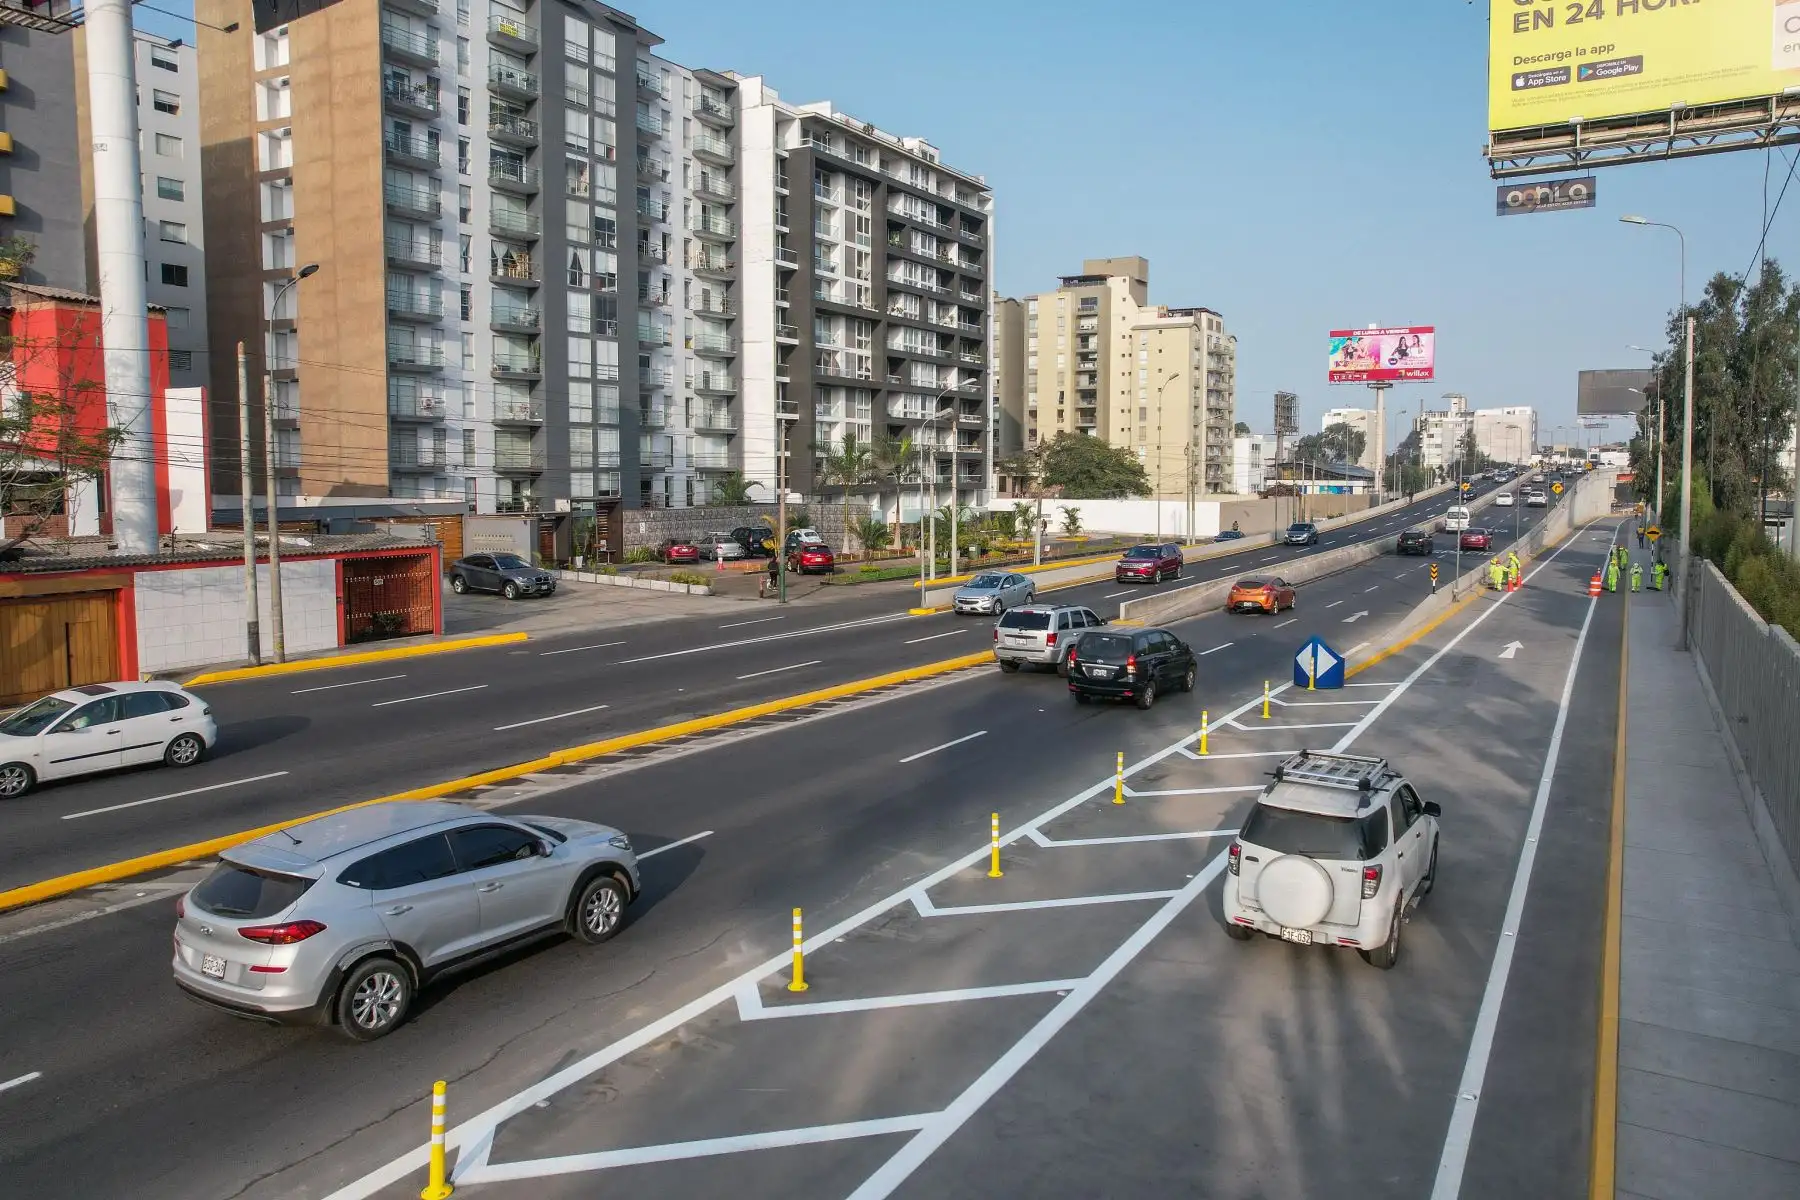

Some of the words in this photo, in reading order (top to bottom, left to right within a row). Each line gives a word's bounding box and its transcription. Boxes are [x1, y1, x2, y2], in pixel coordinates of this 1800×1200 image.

[1513, 7, 1554, 33] EN
[1565, 0, 1605, 24] 24
[1513, 50, 1572, 66] Descarga
[1575, 47, 1586, 57] la
[1590, 43, 1615, 55] app
[1596, 66, 1623, 76] Google
[1623, 63, 1639, 72] Play
[1528, 78, 1544, 86] App
[1545, 75, 1567, 83] Store
[1406, 369, 1429, 377] willax
